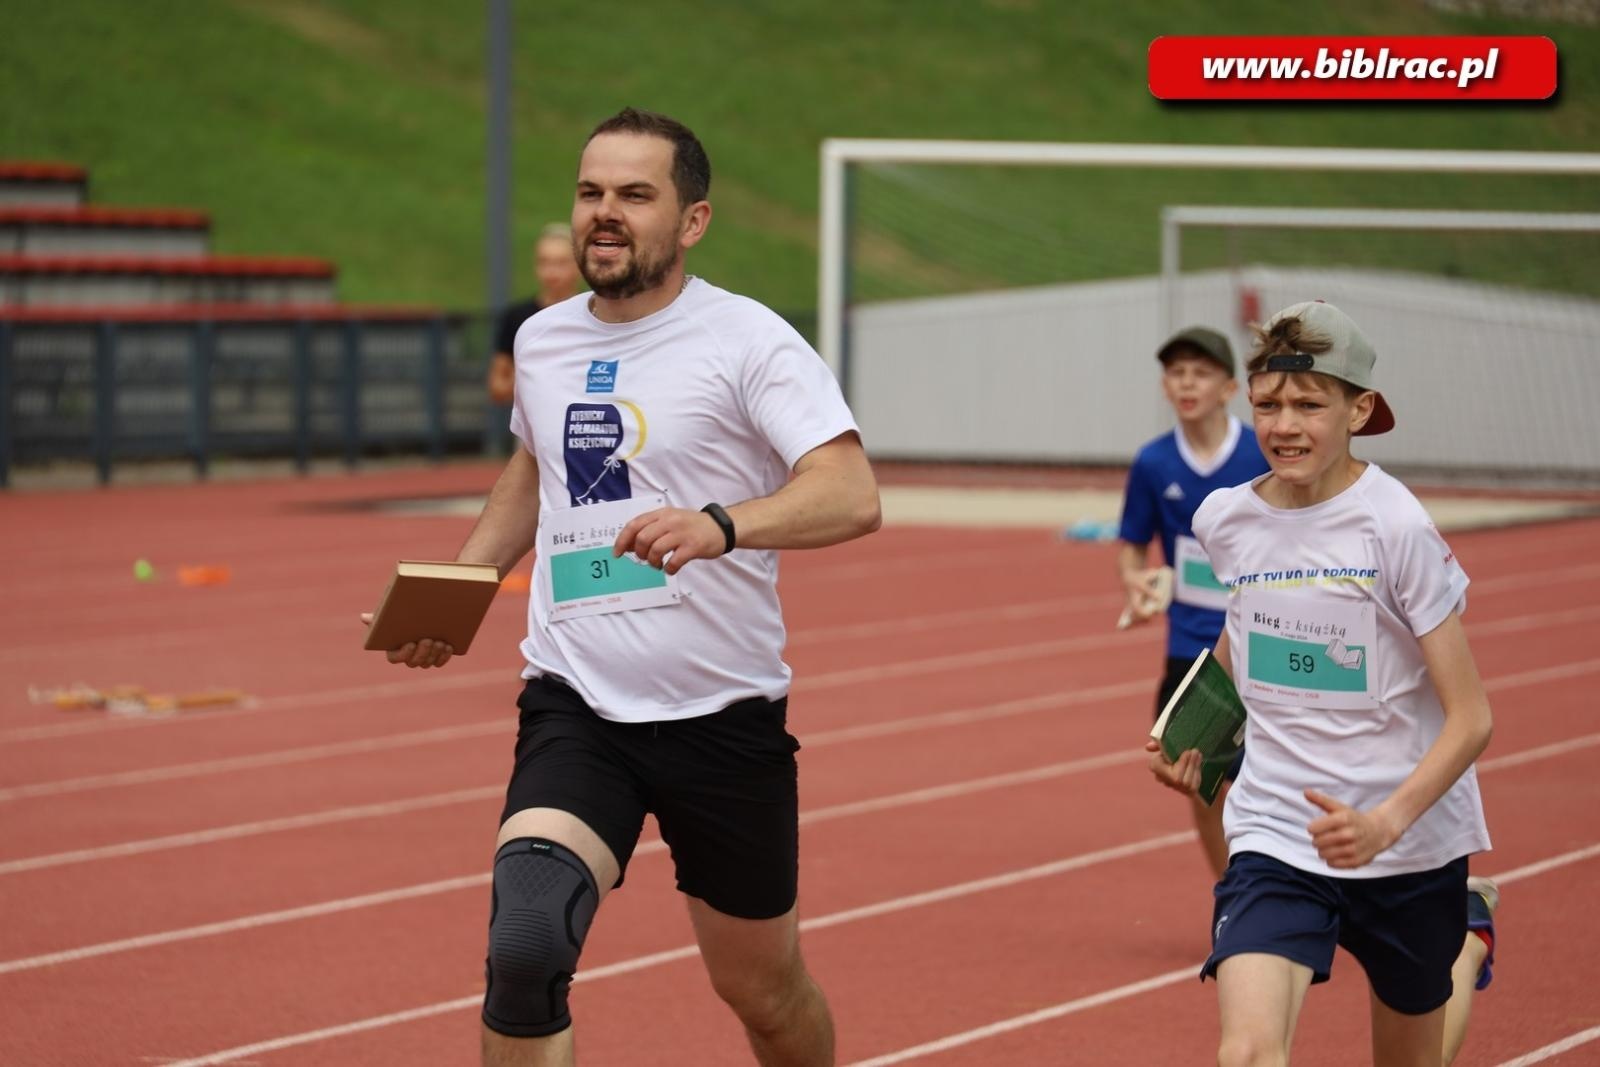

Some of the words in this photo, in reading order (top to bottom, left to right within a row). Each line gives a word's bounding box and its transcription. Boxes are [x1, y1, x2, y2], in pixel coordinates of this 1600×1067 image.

[589, 376, 613, 384] UNIQA
[553, 531, 575, 545] Bieg
[590, 559, 610, 579] 31
[1253, 611, 1280, 630] Bieg
[1295, 619, 1346, 639] książką
[1289, 653, 1315, 673] 59
